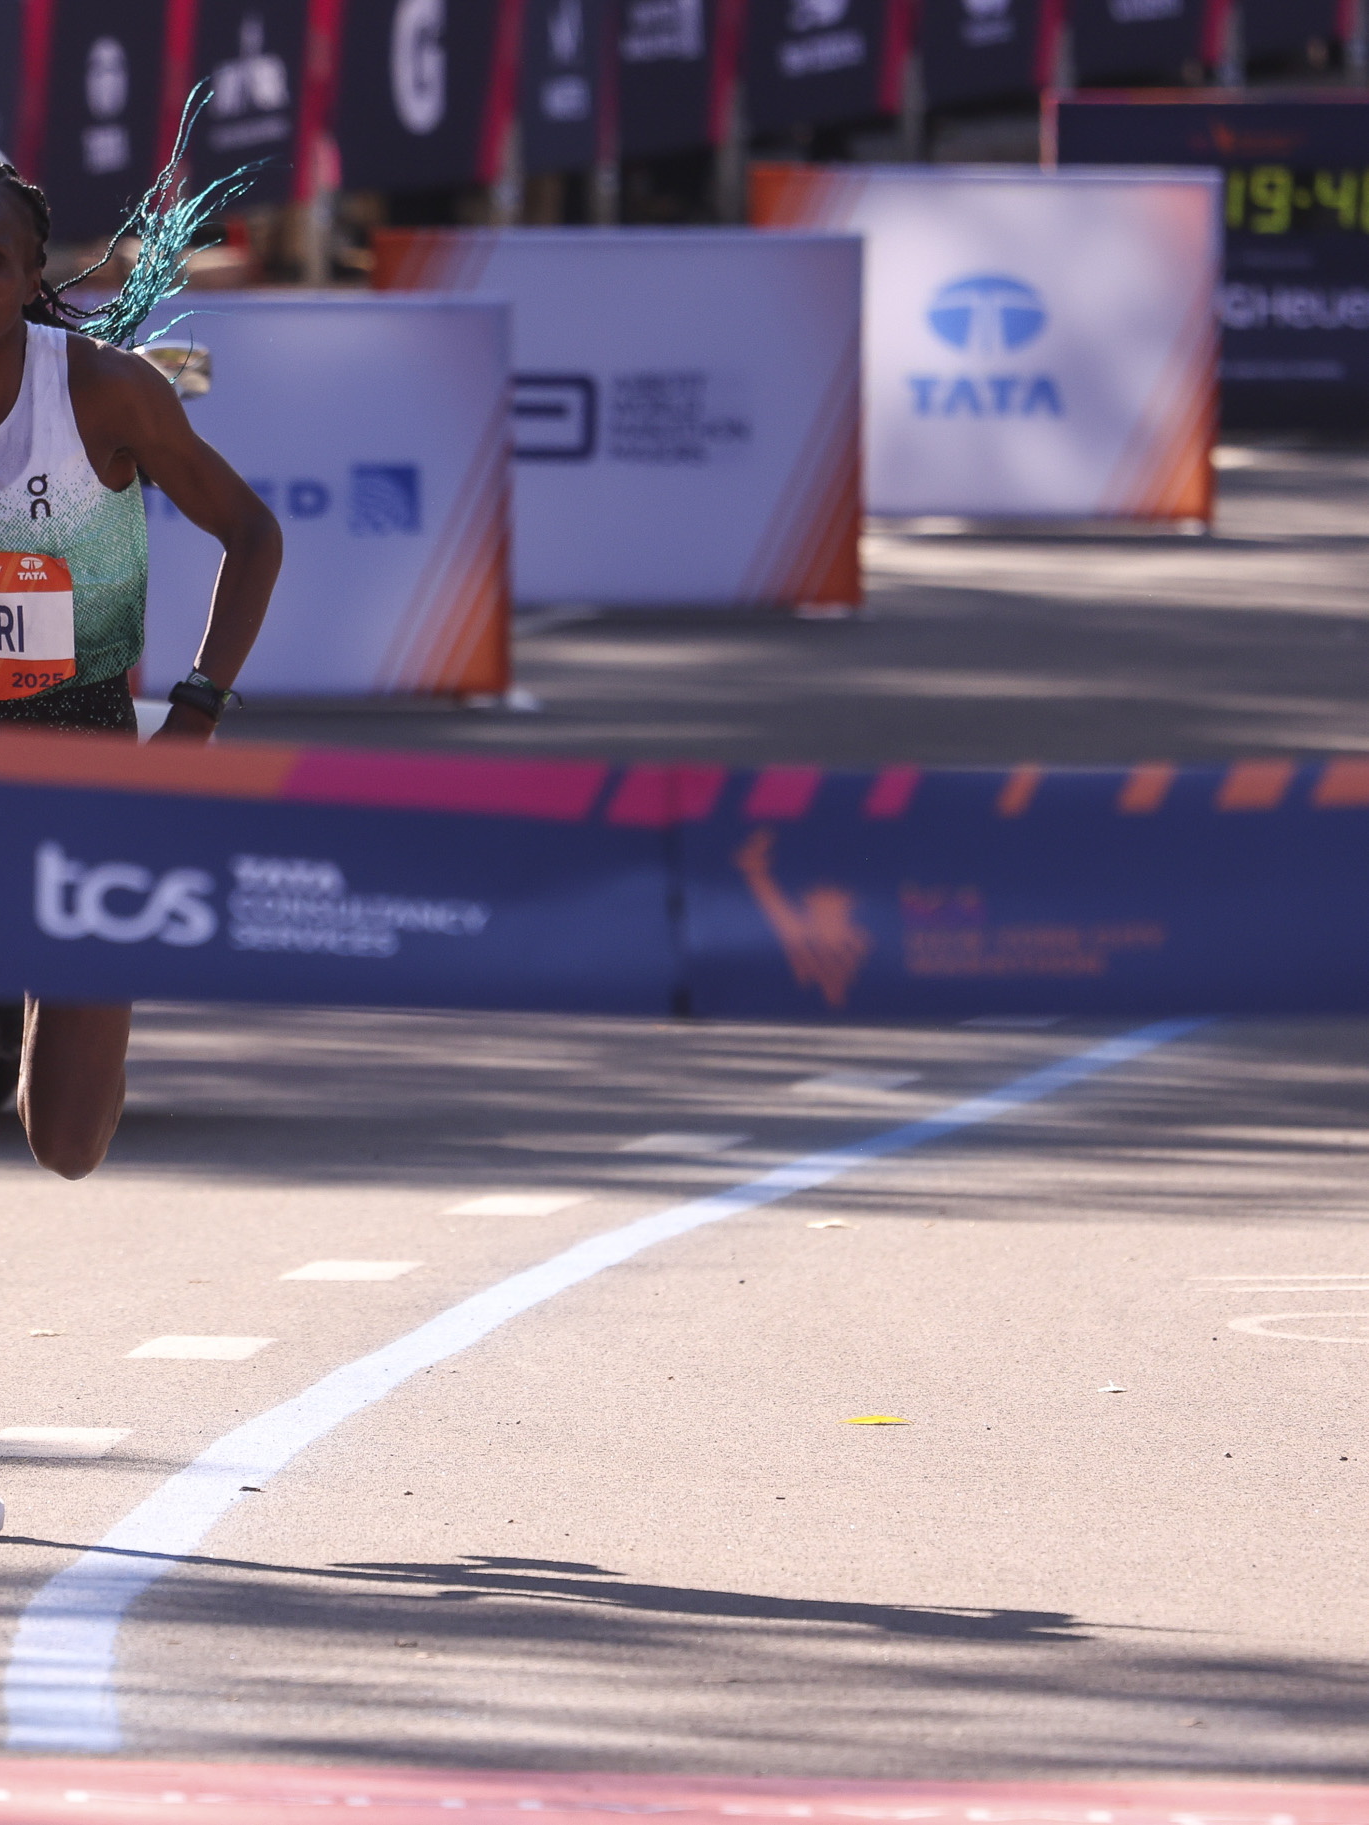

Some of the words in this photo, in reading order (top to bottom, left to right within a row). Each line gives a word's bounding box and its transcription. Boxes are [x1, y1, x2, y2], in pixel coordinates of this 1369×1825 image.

[909, 376, 1064, 419] TATA
[17, 571, 48, 581] TATA
[11, 672, 64, 689] 2025
[34, 839, 219, 948] tcs
[232, 854, 345, 896] TATA
[231, 892, 491, 937] CONSULTANCY
